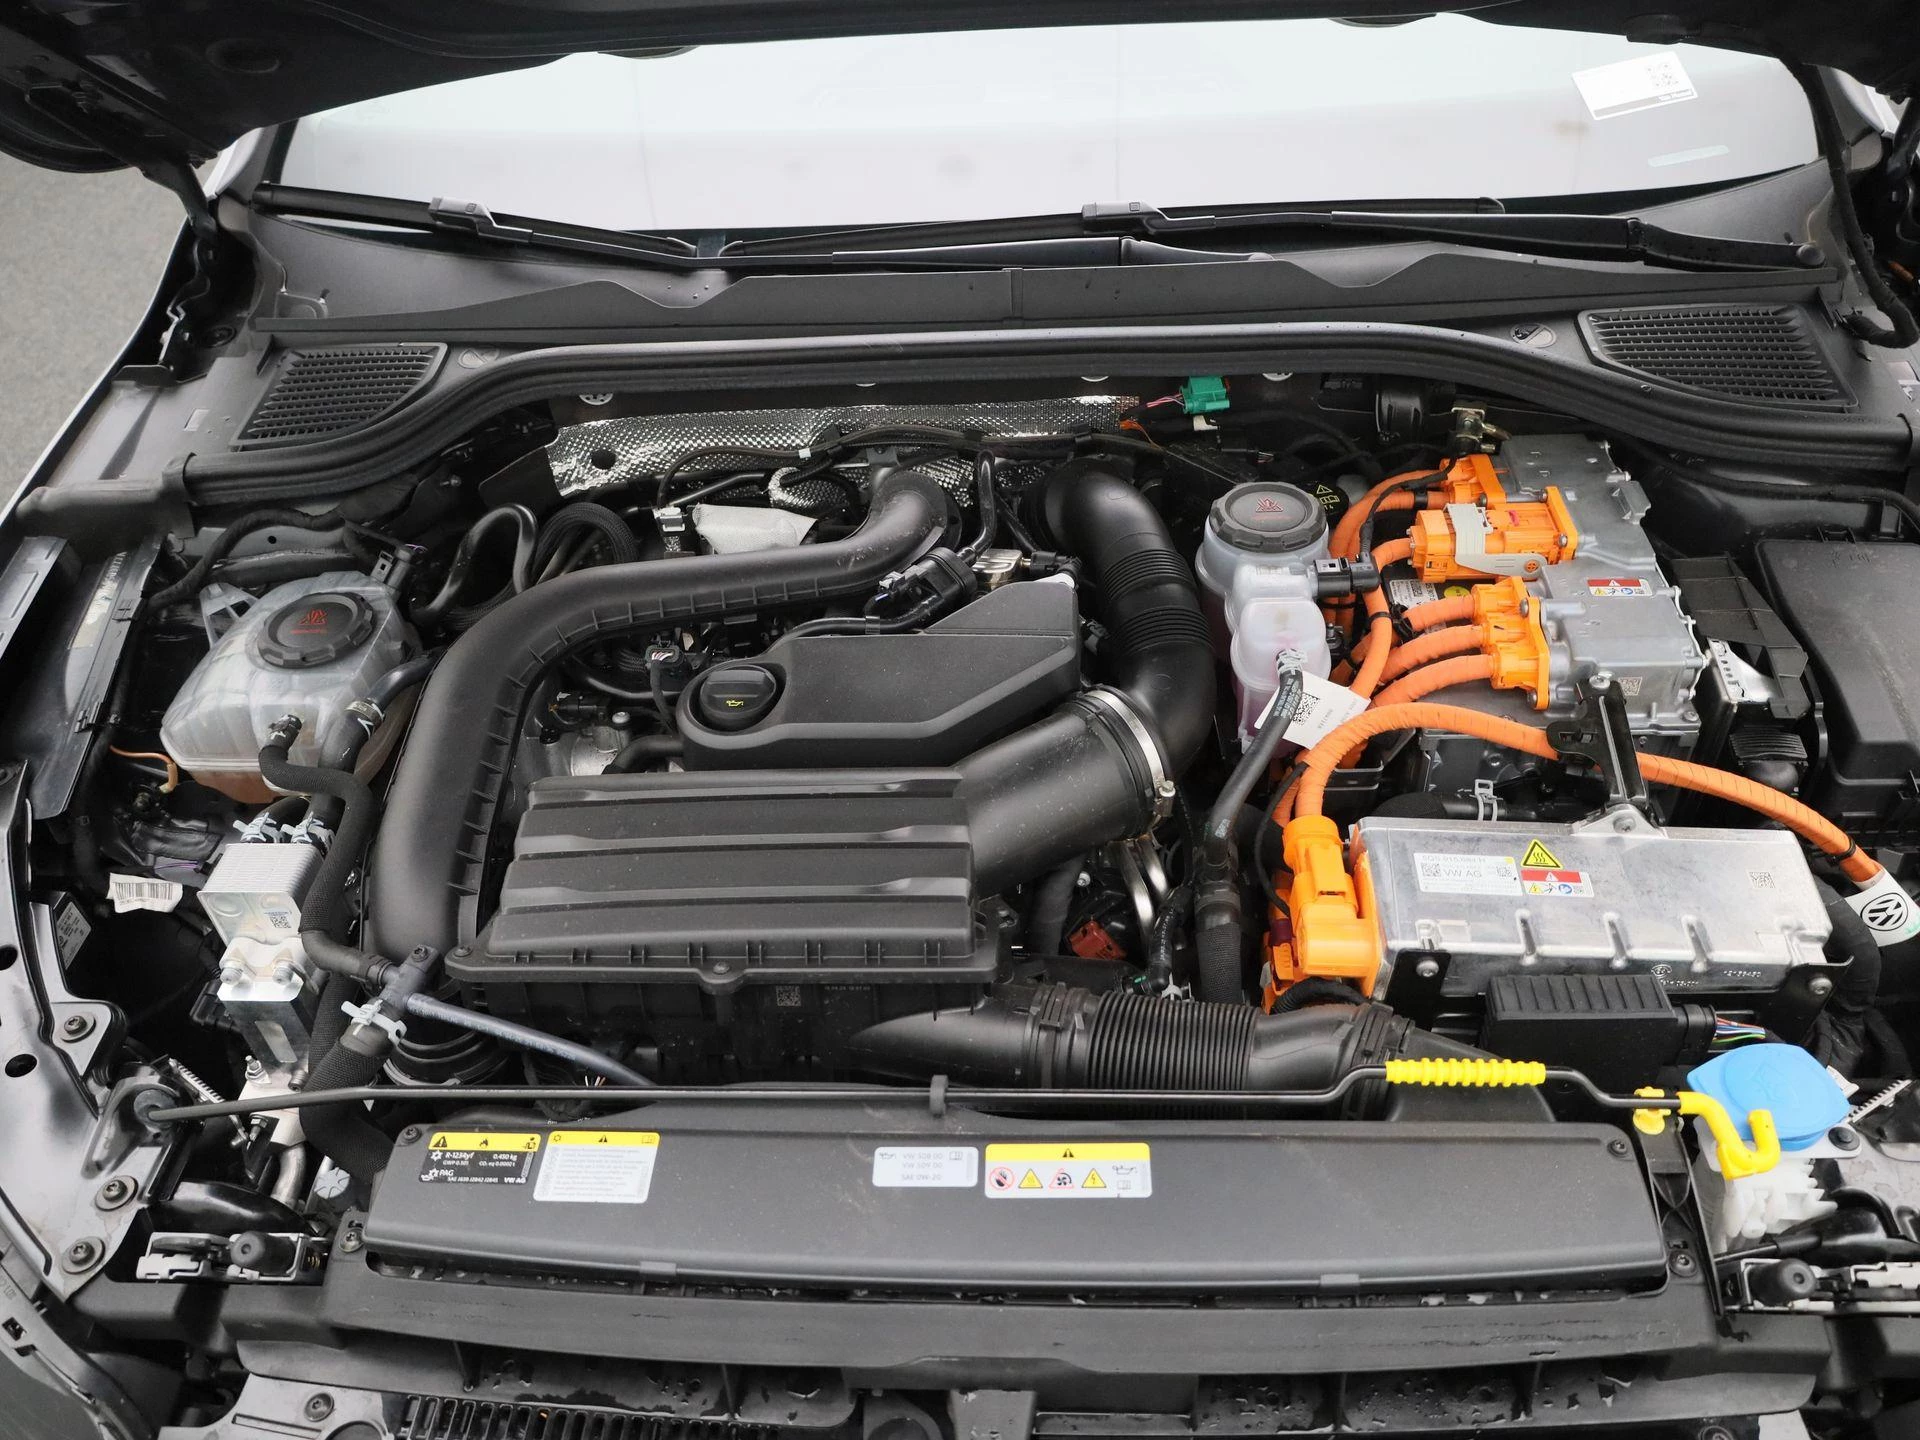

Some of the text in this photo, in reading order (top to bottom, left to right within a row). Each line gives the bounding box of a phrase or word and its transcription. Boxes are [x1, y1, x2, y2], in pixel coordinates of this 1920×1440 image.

[1443, 869, 1482, 878] VW AG
[445, 1151, 475, 1160] R-1234yf
